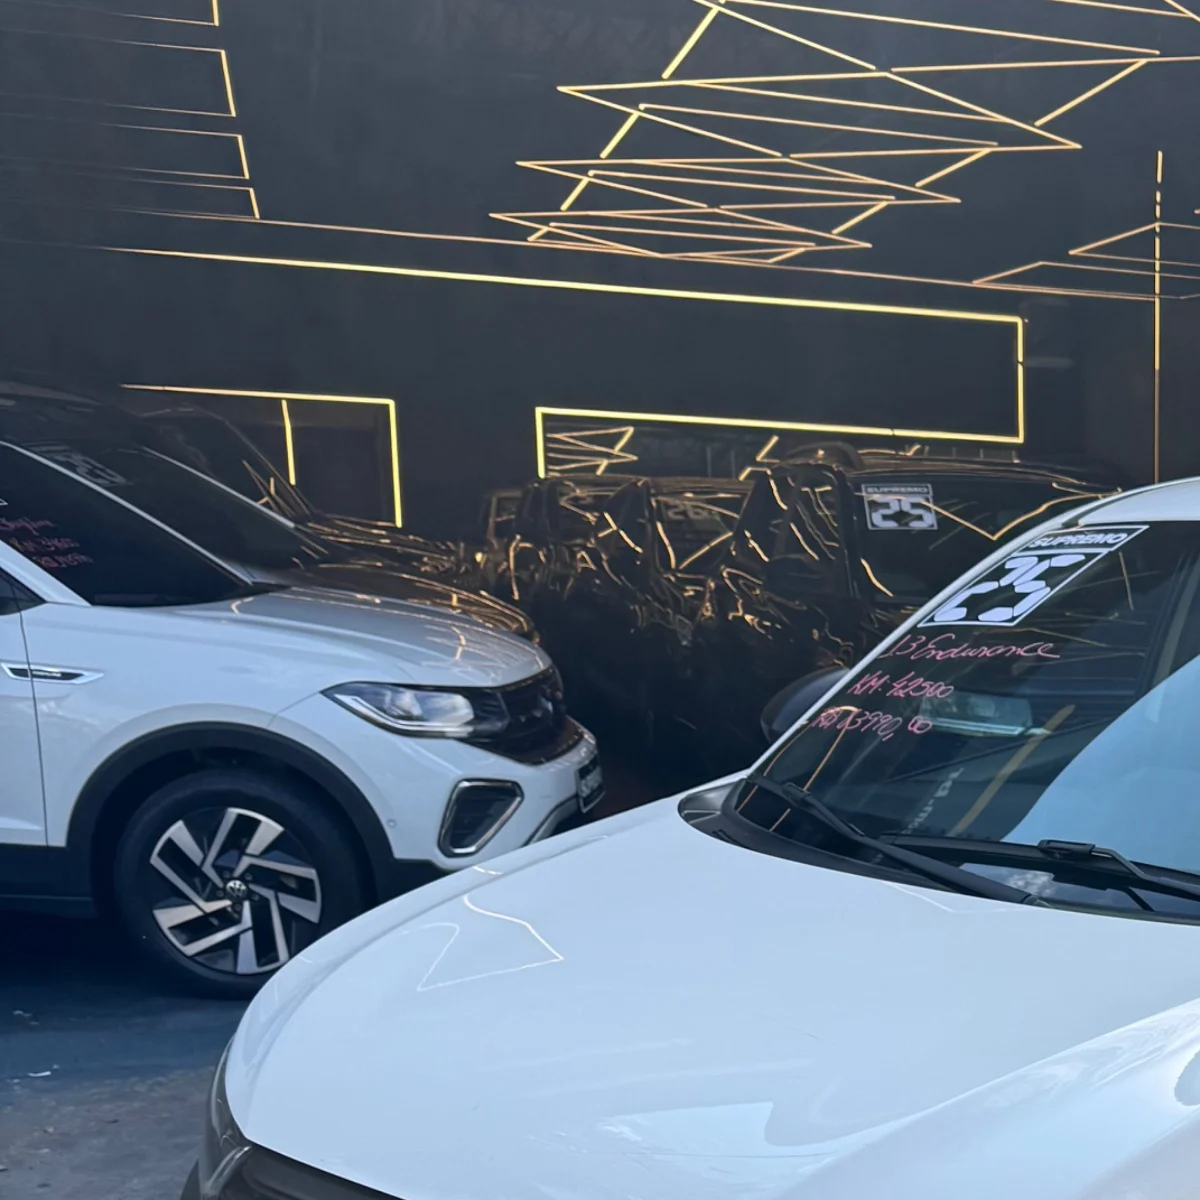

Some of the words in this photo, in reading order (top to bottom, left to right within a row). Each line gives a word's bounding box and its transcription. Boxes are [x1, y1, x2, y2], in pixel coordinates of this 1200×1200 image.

[872, 497, 933, 528] 25
[1029, 533, 1128, 548] SUPREMO
[934, 554, 1086, 622] 25
[911, 633, 1060, 660] Endurance
